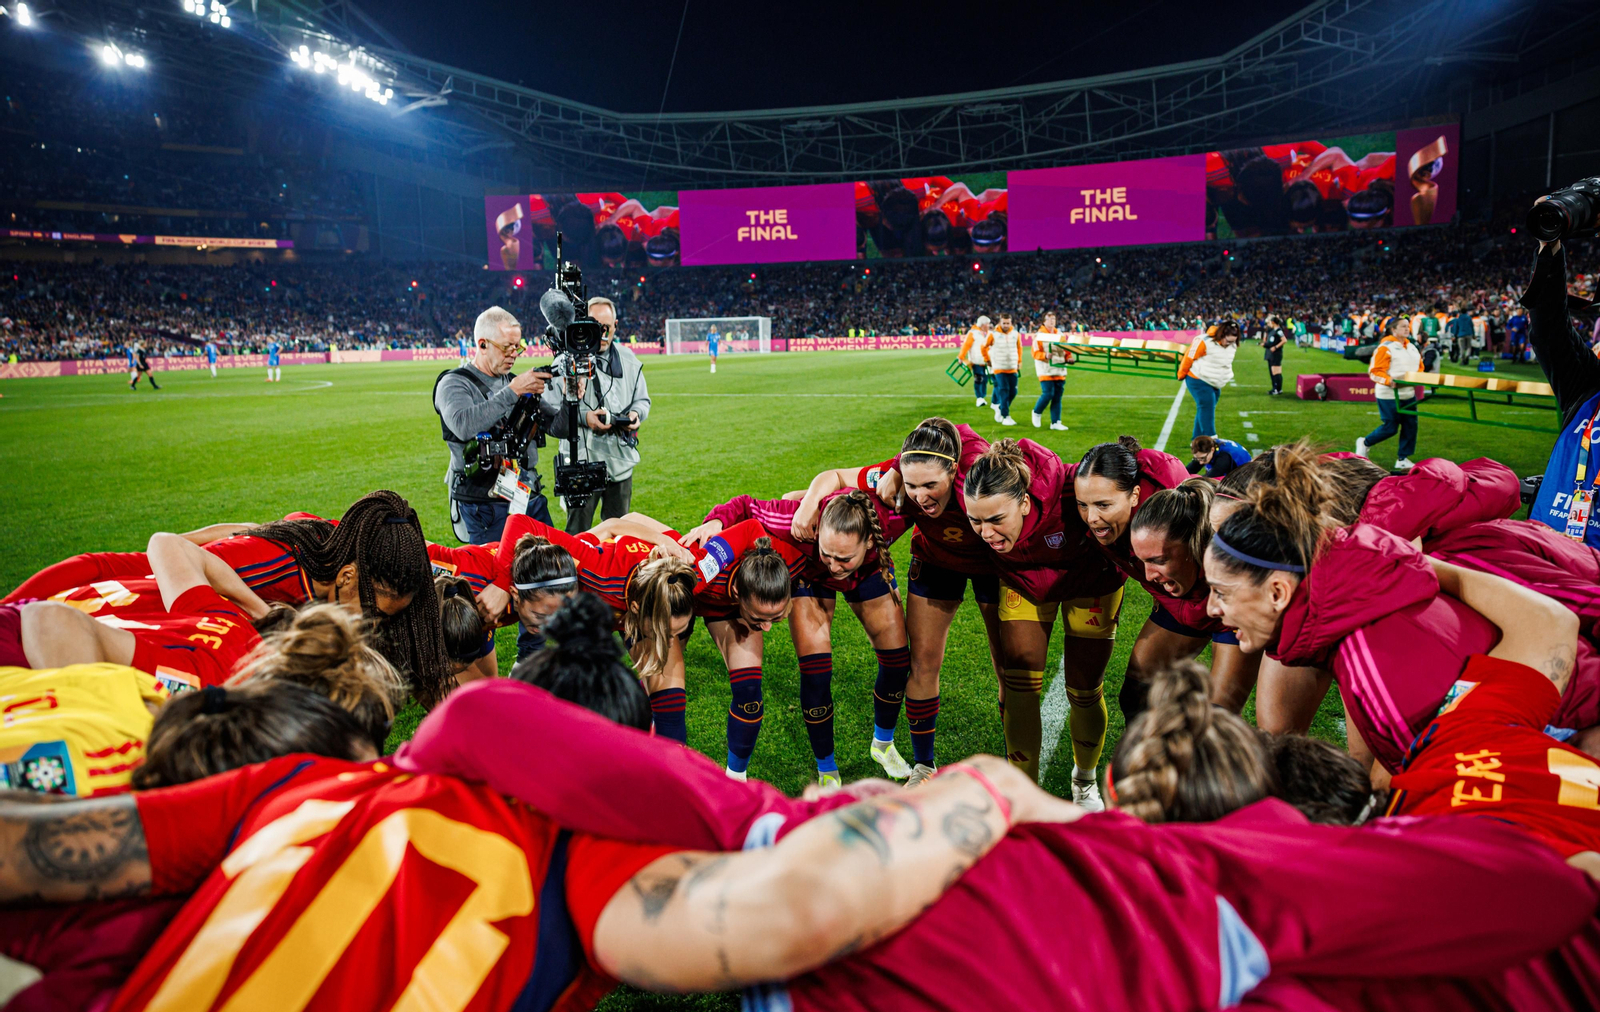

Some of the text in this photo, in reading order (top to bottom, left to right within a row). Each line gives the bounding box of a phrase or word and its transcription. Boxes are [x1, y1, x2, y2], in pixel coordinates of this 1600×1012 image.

[1080, 186, 1127, 206] THE
[746, 209, 788, 225] THE
[1070, 204, 1138, 224] FINAL
[63, 232, 95, 240] ENGLAND
[737, 225, 798, 242] FINAL
